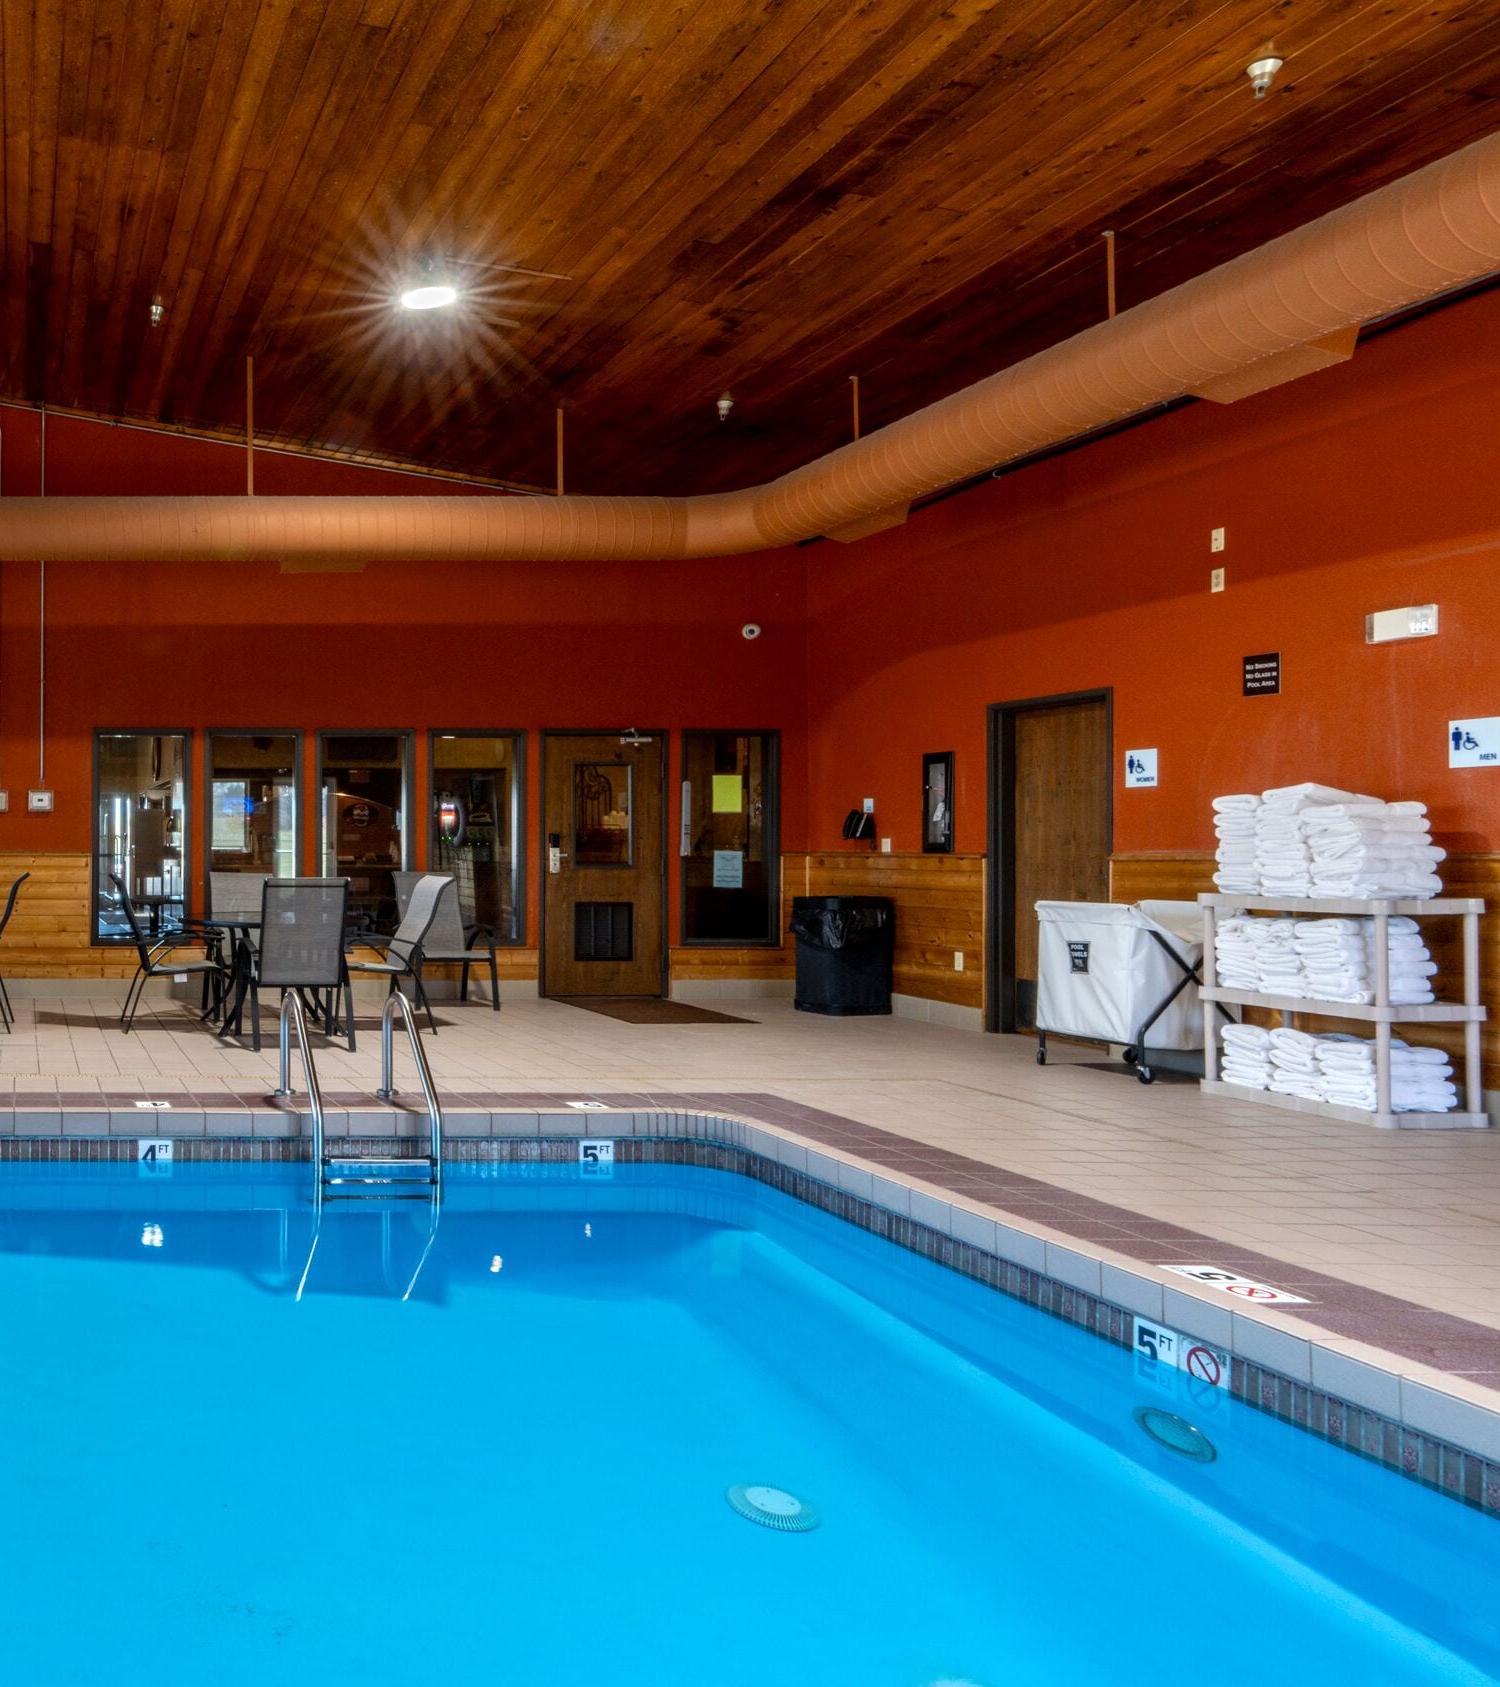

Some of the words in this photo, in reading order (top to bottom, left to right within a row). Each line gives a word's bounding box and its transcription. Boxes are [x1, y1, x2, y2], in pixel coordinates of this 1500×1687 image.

[142, 1145, 156, 1162] 4
[159, 1145, 169, 1153] FT
[583, 1145, 599, 1163] 5
[600, 1145, 610, 1154] FT
[1138, 1325, 1158, 1361] 5
[1159, 1335, 1173, 1352] FT
